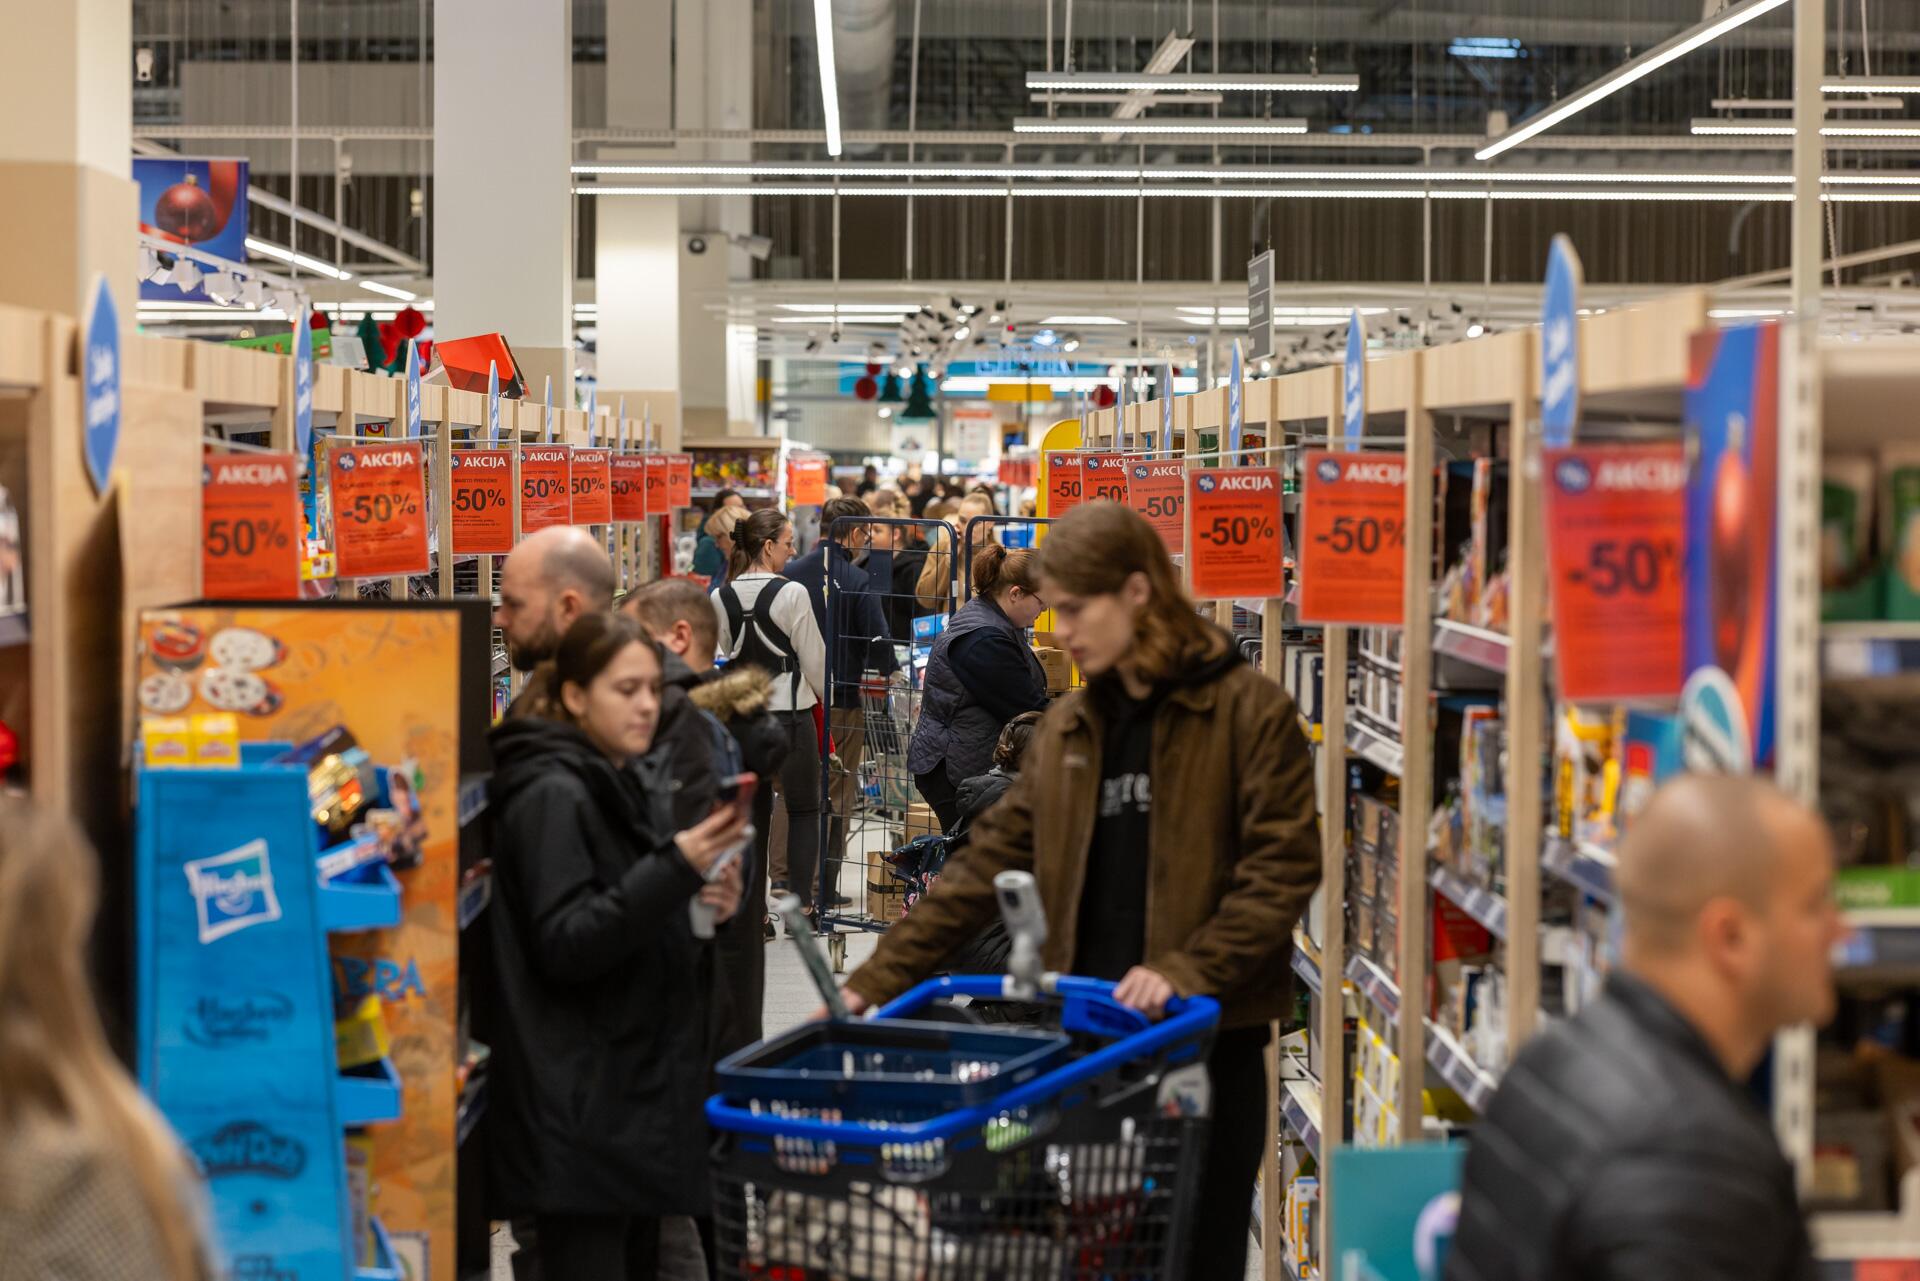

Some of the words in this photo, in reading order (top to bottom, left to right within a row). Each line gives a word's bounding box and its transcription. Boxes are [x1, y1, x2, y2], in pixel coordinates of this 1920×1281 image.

[360, 451, 414, 468] AKCIJA
[463, 456, 506, 468] AKCIJA
[529, 452, 565, 462] AKCIJA
[574, 454, 605, 463] AKCIJA
[217, 464, 288, 486] AKCIJA
[1220, 476, 1273, 491] AKCIJA
[1345, 463, 1407, 486] AKCIJ
[521, 478, 565, 498] 50%
[342, 493, 416, 524] -50%
[204, 518, 289, 557] 50%
[1200, 516, 1274, 546] -50%
